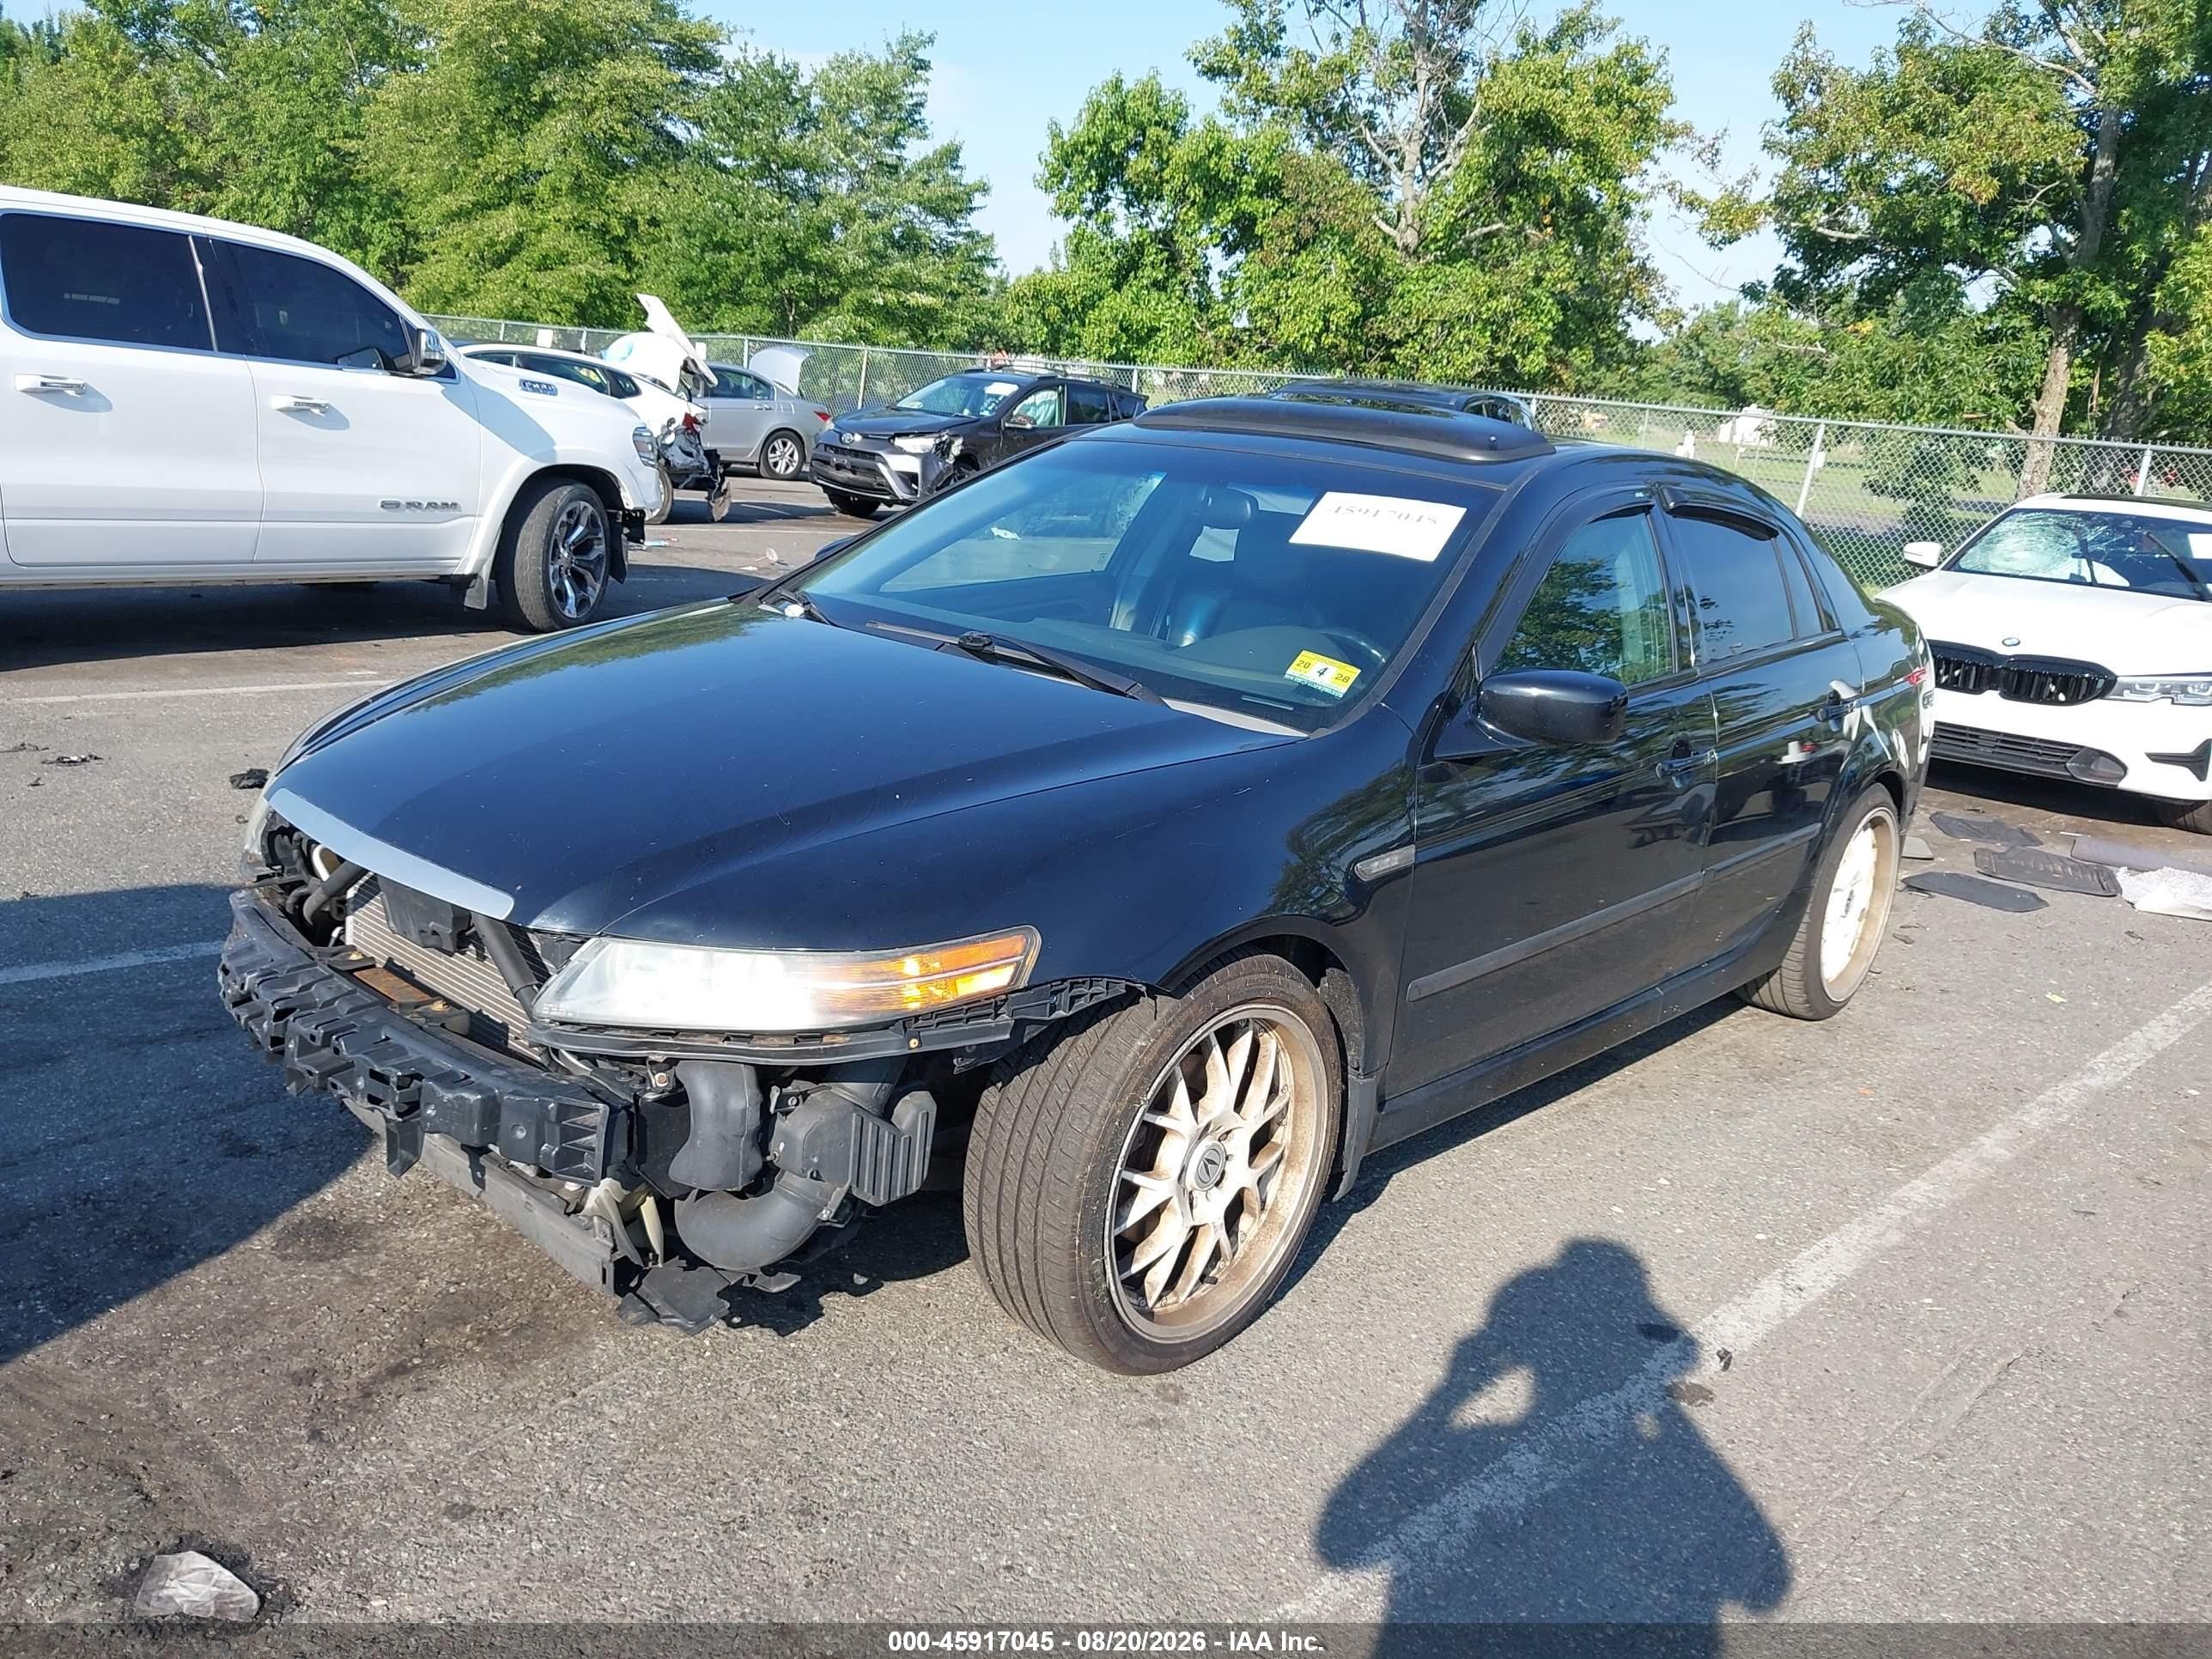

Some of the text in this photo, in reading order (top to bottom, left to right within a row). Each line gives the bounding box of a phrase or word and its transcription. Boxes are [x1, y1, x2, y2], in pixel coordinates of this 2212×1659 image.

[404, 501, 459, 510] RAM
[1296, 659, 1311, 669] 20
[1316, 666, 1328, 677] 4
[1334, 673, 1351, 684] 28
